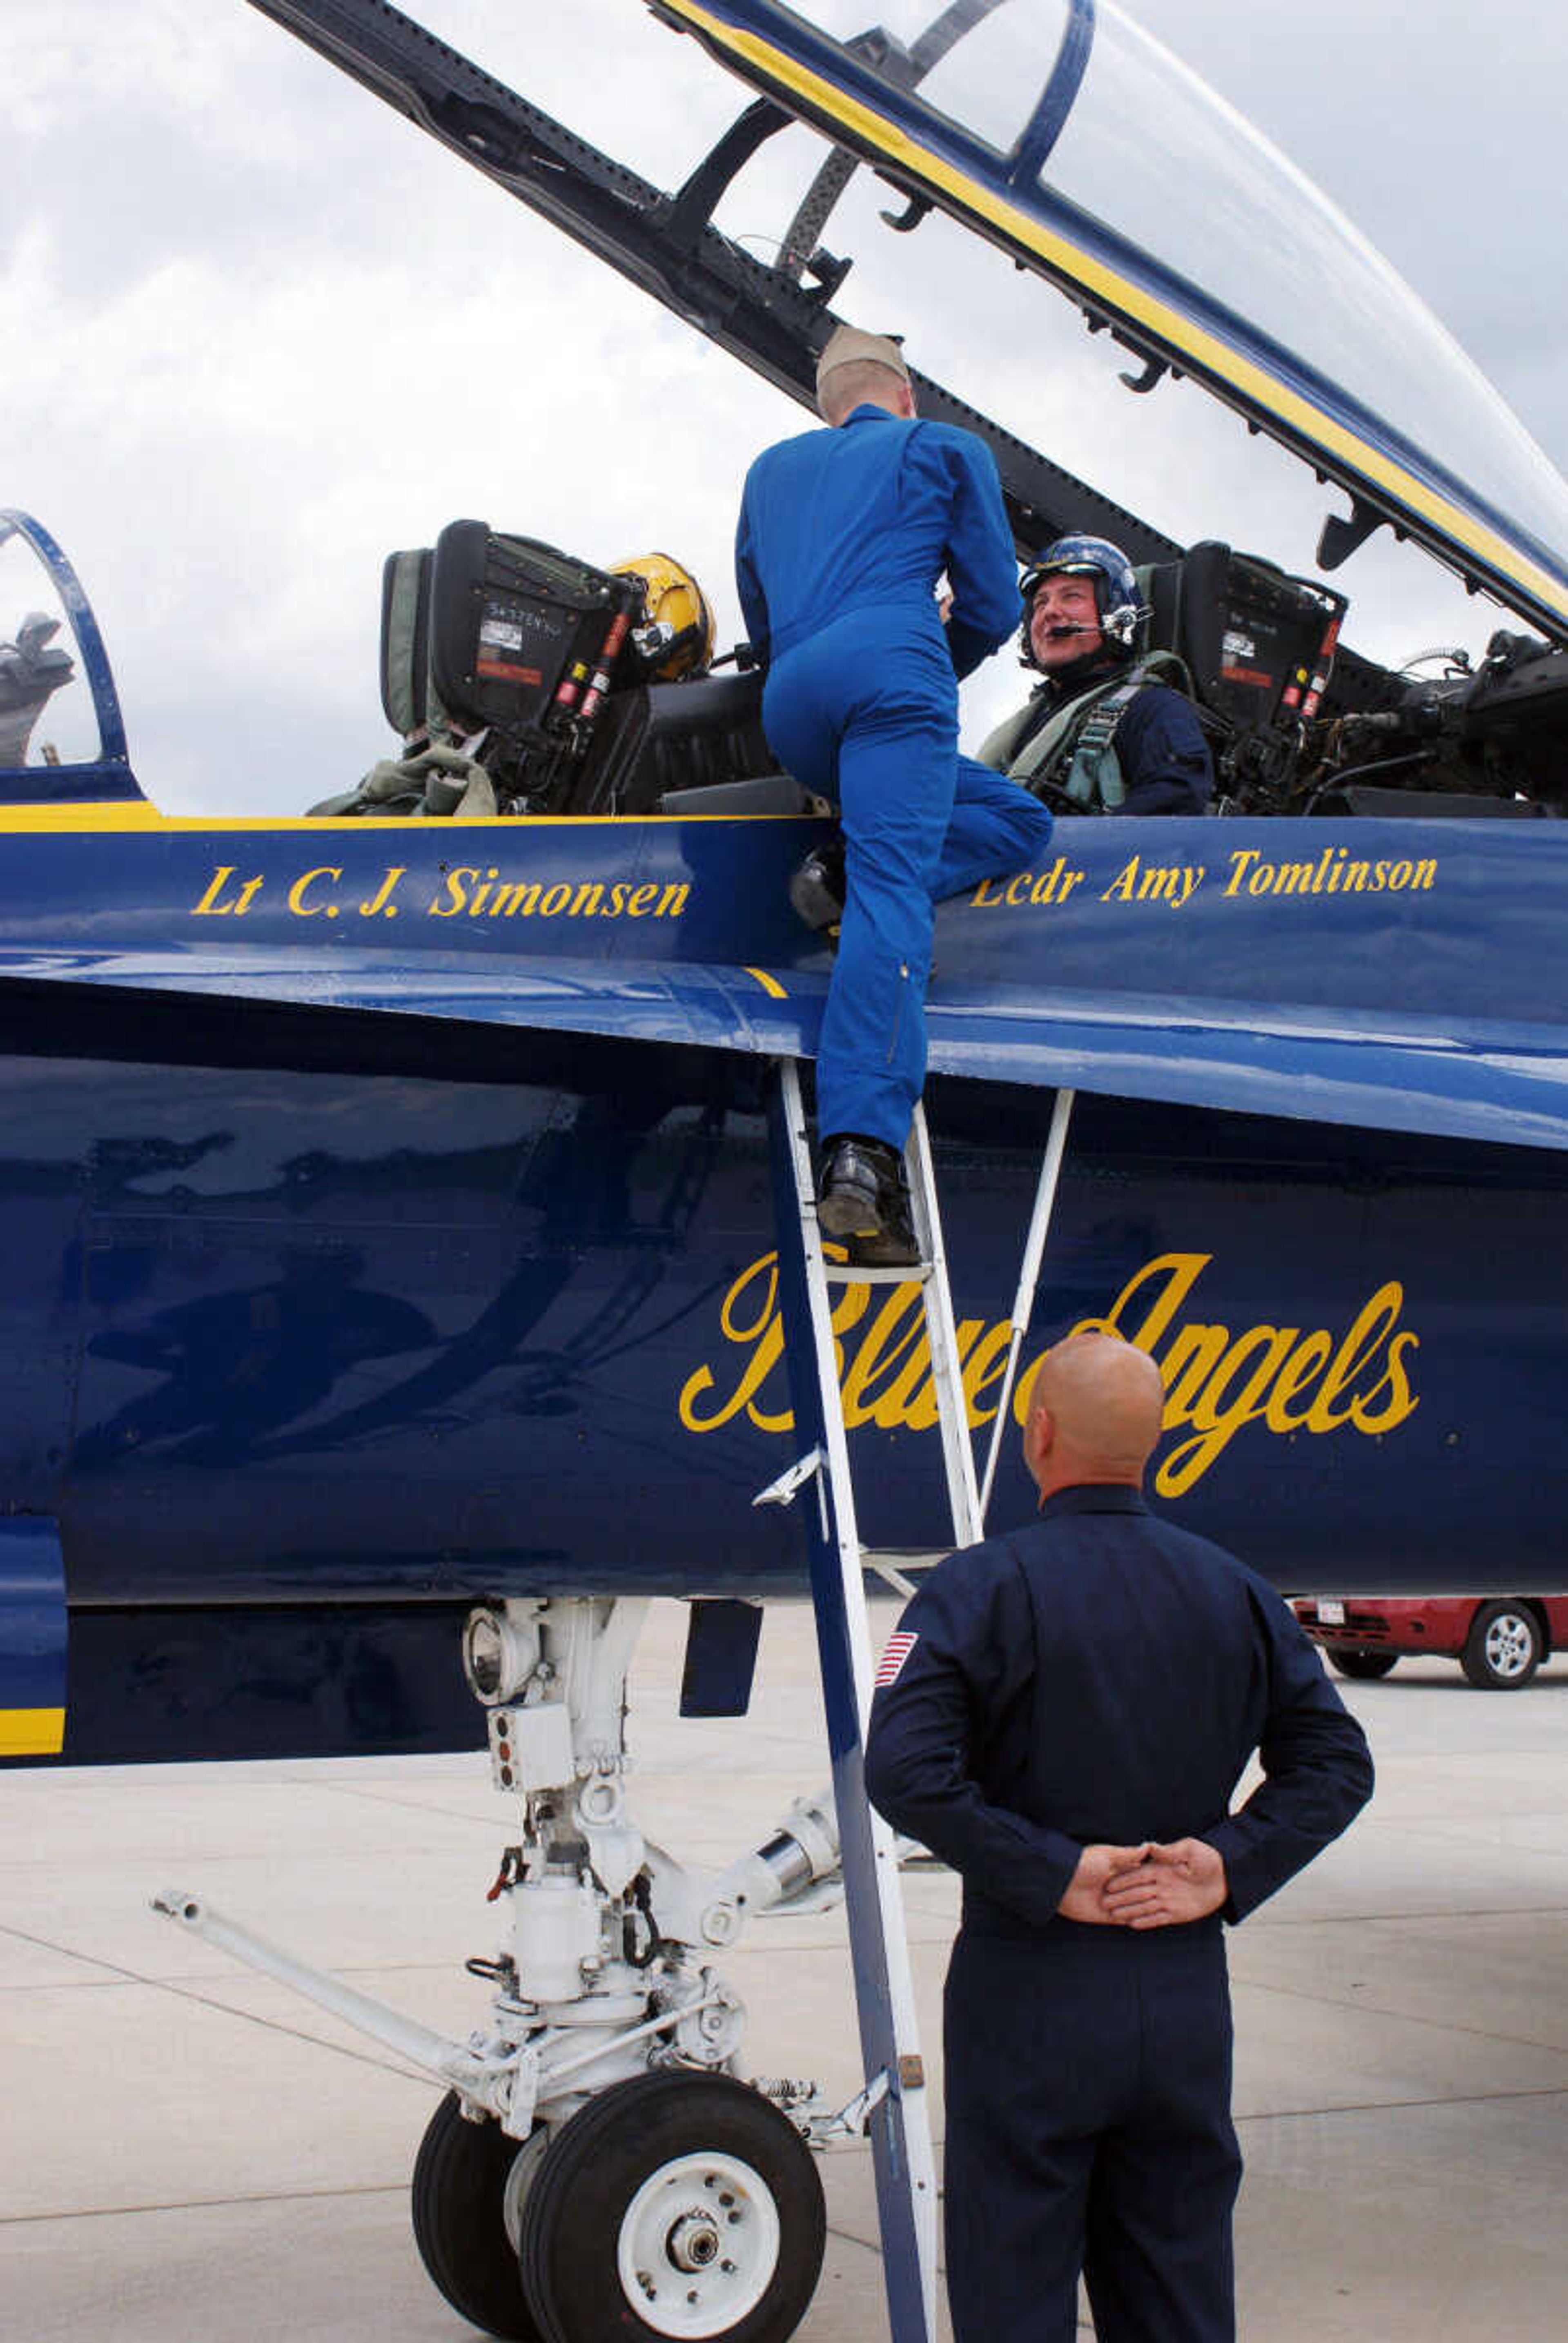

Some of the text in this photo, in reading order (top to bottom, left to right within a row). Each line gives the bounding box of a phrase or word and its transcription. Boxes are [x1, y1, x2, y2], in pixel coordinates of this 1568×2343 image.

[190, 866, 691, 918] Lt C. J. Simonsen
[968, 847, 1438, 908] Lcdr Amy Tomlinson
[679, 1241, 1015, 1432] Blue
